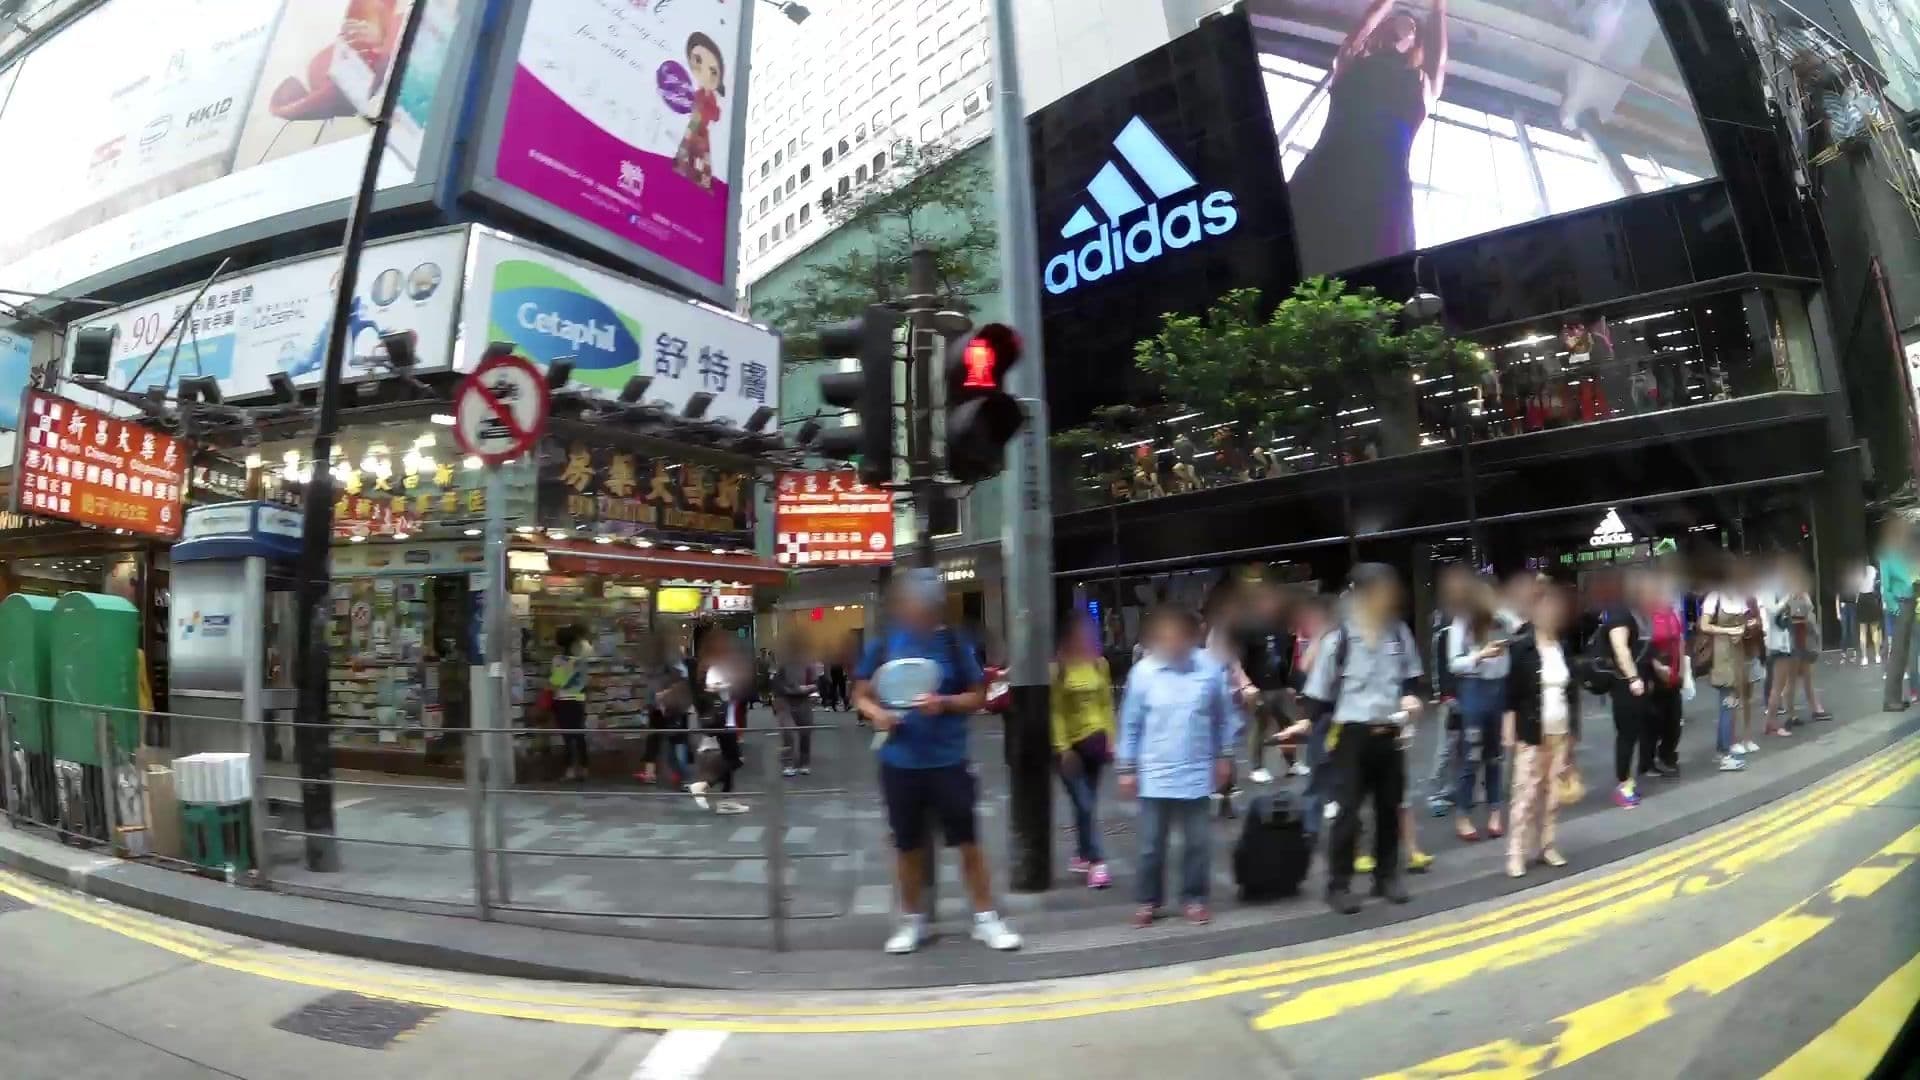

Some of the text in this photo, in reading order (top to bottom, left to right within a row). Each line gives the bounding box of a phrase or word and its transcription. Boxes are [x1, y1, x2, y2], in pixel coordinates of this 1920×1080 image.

[1044, 190, 1238, 294] adidas
[517, 302, 616, 352] Cetaphil
[1589, 532, 1634, 546] adidas
